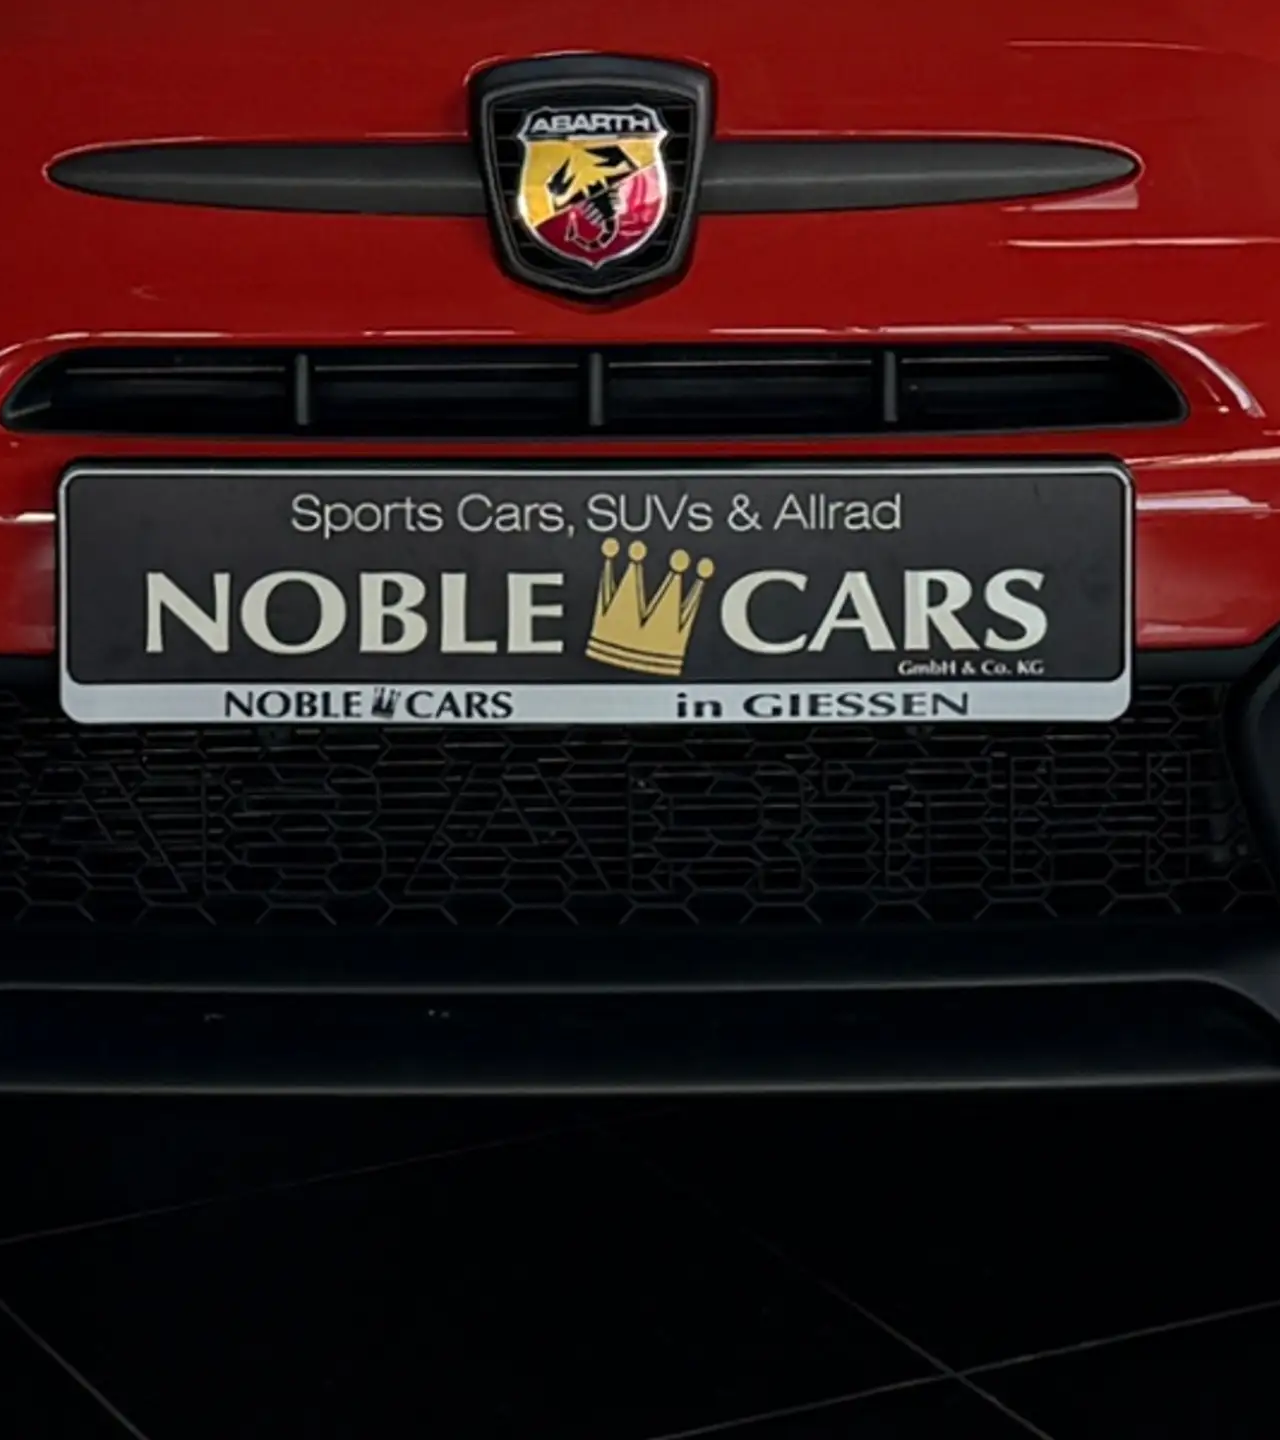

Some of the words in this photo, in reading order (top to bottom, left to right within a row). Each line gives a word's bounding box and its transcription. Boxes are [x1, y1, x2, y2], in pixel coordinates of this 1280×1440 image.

[531, 114, 649, 133] ABARTH
[291, 493, 443, 540] Sports
[457, 493, 575, 537] Cars,
[587, 492, 713, 533] SUVs
[727, 493, 762, 532] &
[773, 492, 901, 531] Allrad
[146, 570, 564, 654] NOBLE
[720, 568, 1048, 654] CARS
[898, 660, 956, 675] GmbH
[961, 660, 976, 675] &
[981, 660, 1013, 675] Co.
[1017, 660, 1044, 675] KG
[224, 690, 363, 718] NOBLE
[405, 690, 513, 719] CARS
[677, 692, 723, 718] in
[742, 691, 969, 717] GIESSEN
